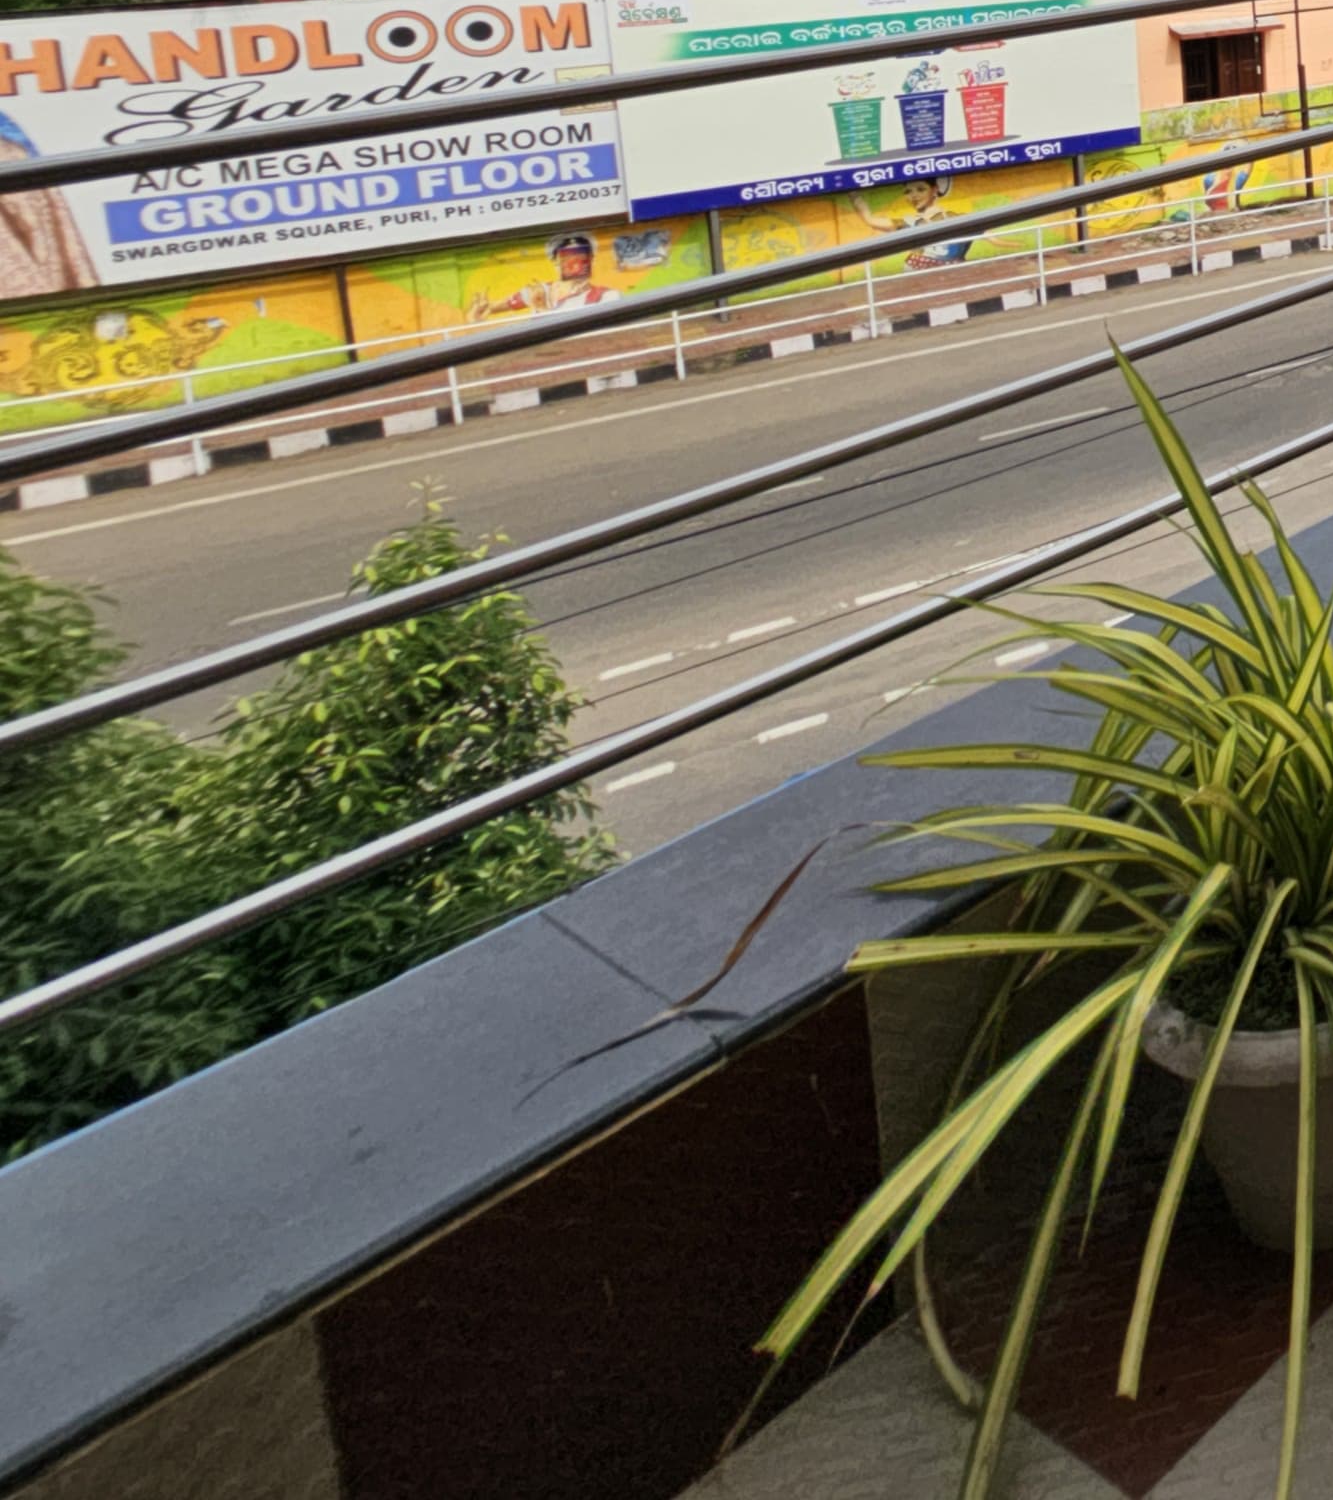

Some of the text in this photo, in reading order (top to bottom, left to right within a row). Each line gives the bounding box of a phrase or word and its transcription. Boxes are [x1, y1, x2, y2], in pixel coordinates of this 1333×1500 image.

[0, 1, 592, 97] HANDLOOM
[103, 61, 545, 146] Garden
[131, 122, 593, 195] A/C MEGA SHOW ROOM
[138, 150, 595, 234] GROUND FLOOR
[851, 166, 895, 188] ପୁରୀ
[1024, 141, 1063, 161] ପୁରୀ
[111, 231, 268, 264] SWARGDWAR
[275, 218, 374, 239] SQUARE,
[380, 209, 438, 228] PURI,
[444, 204, 472, 219] PH
[490, 184, 623, 213] 06752-220037
